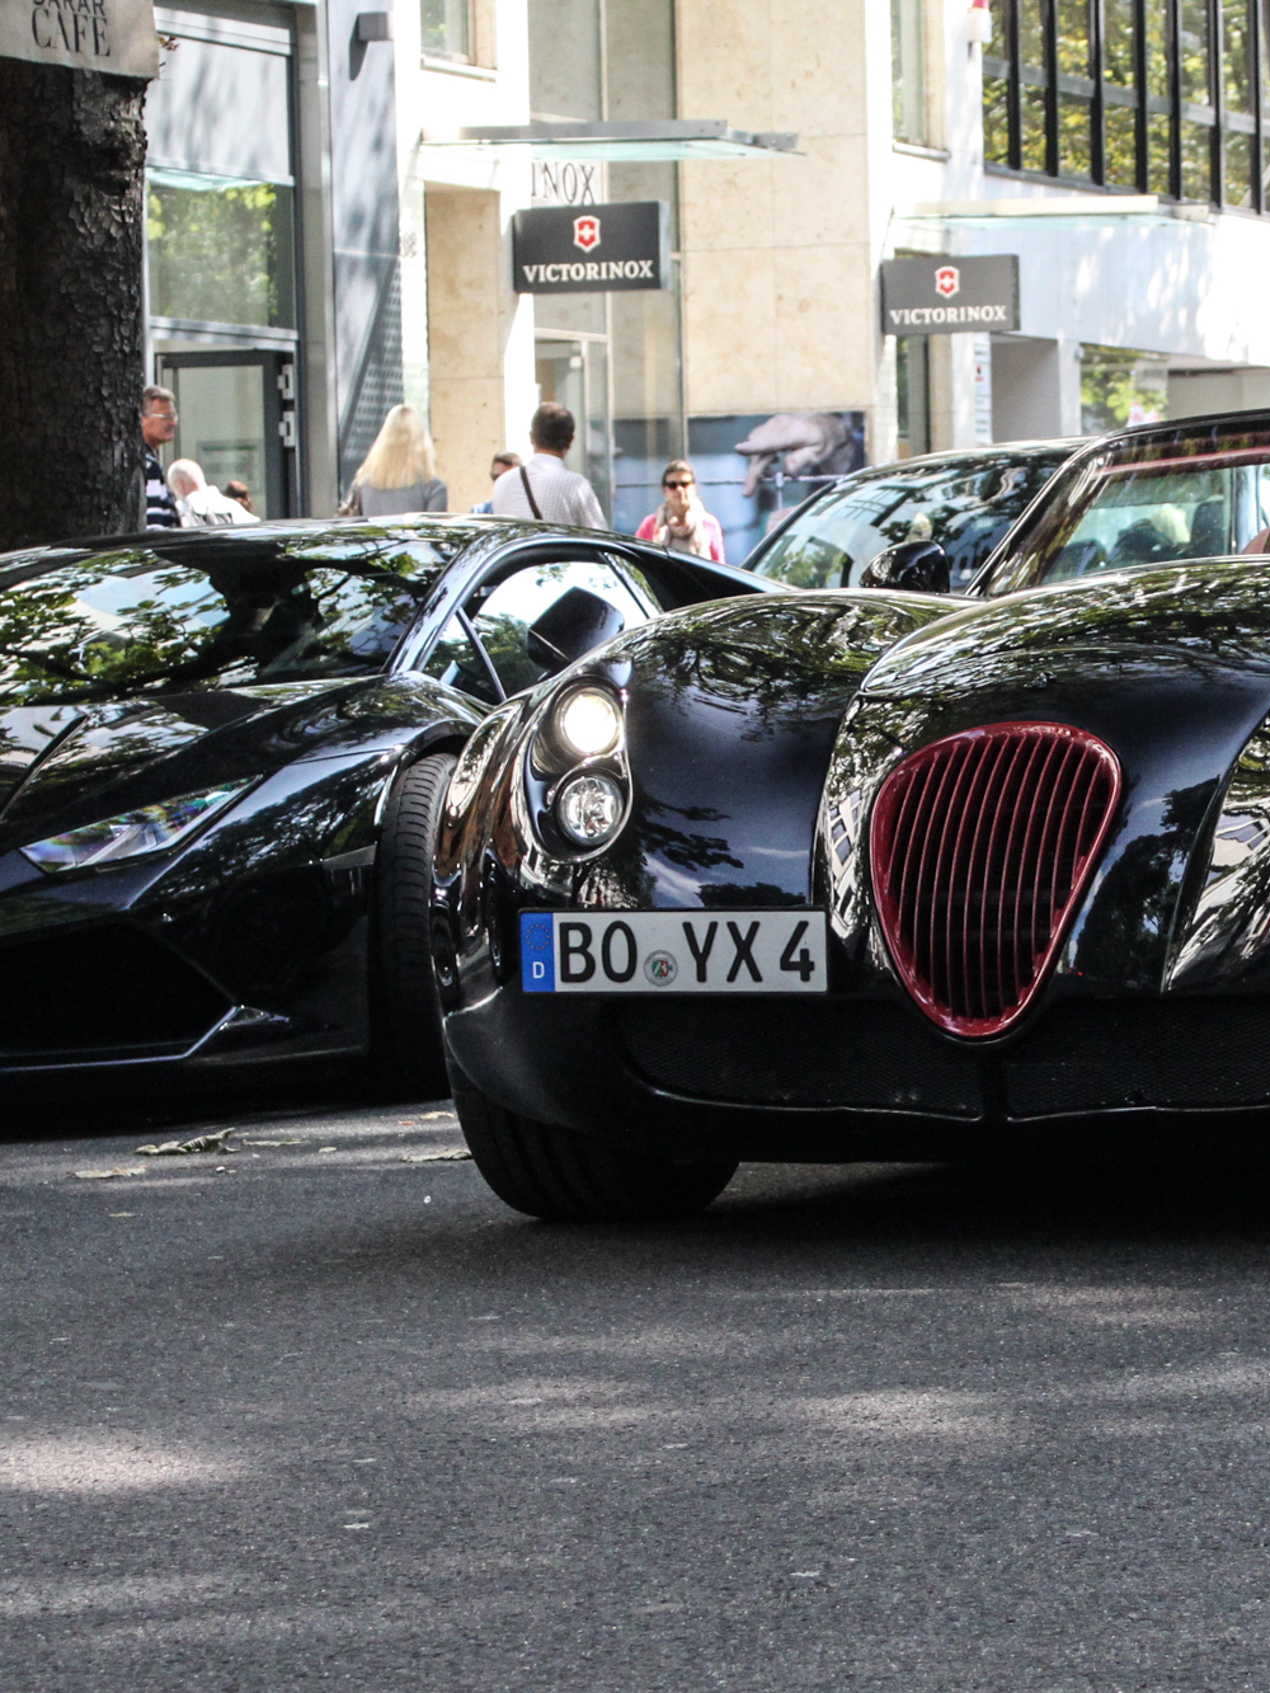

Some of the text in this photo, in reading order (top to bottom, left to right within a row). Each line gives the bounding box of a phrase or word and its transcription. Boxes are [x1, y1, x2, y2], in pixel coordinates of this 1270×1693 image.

[32, 8, 110, 57] CAFE
[522, 260, 653, 283] VICTORINOX
[889, 305, 1006, 325] VICTORINOX
[559, 920, 814, 983] BO YX 4
[532, 962, 545, 979] D
